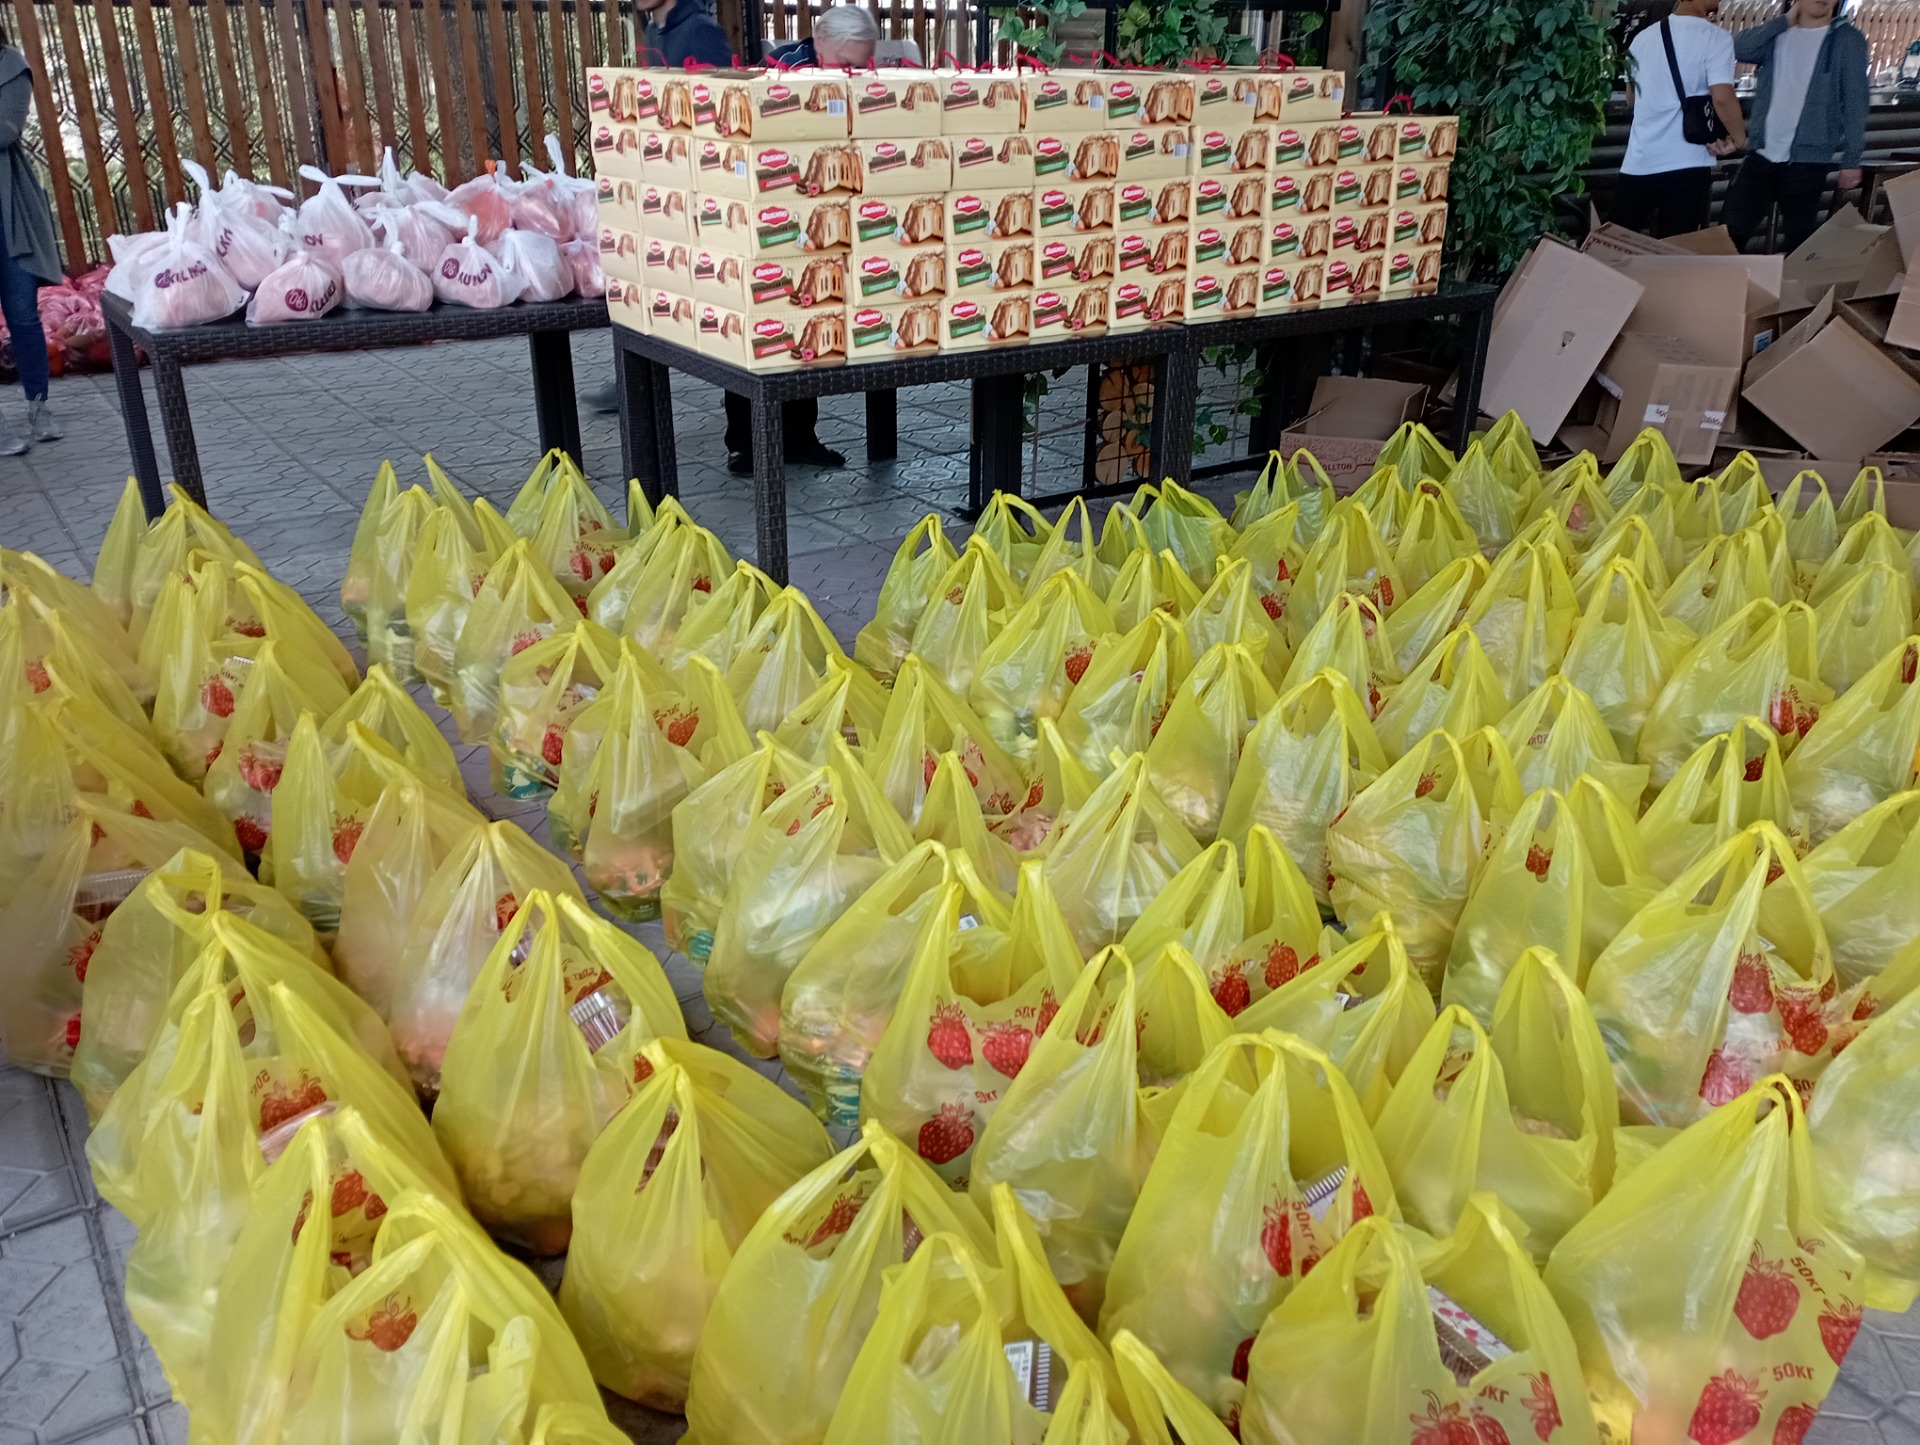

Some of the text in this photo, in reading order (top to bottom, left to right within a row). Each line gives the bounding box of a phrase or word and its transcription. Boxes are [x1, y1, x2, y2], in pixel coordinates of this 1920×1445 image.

[1322, 463, 1352, 471] OLLTON
[1791, 1257, 1826, 1295] 50кг
[1773, 1362, 1814, 1382] 50кг
